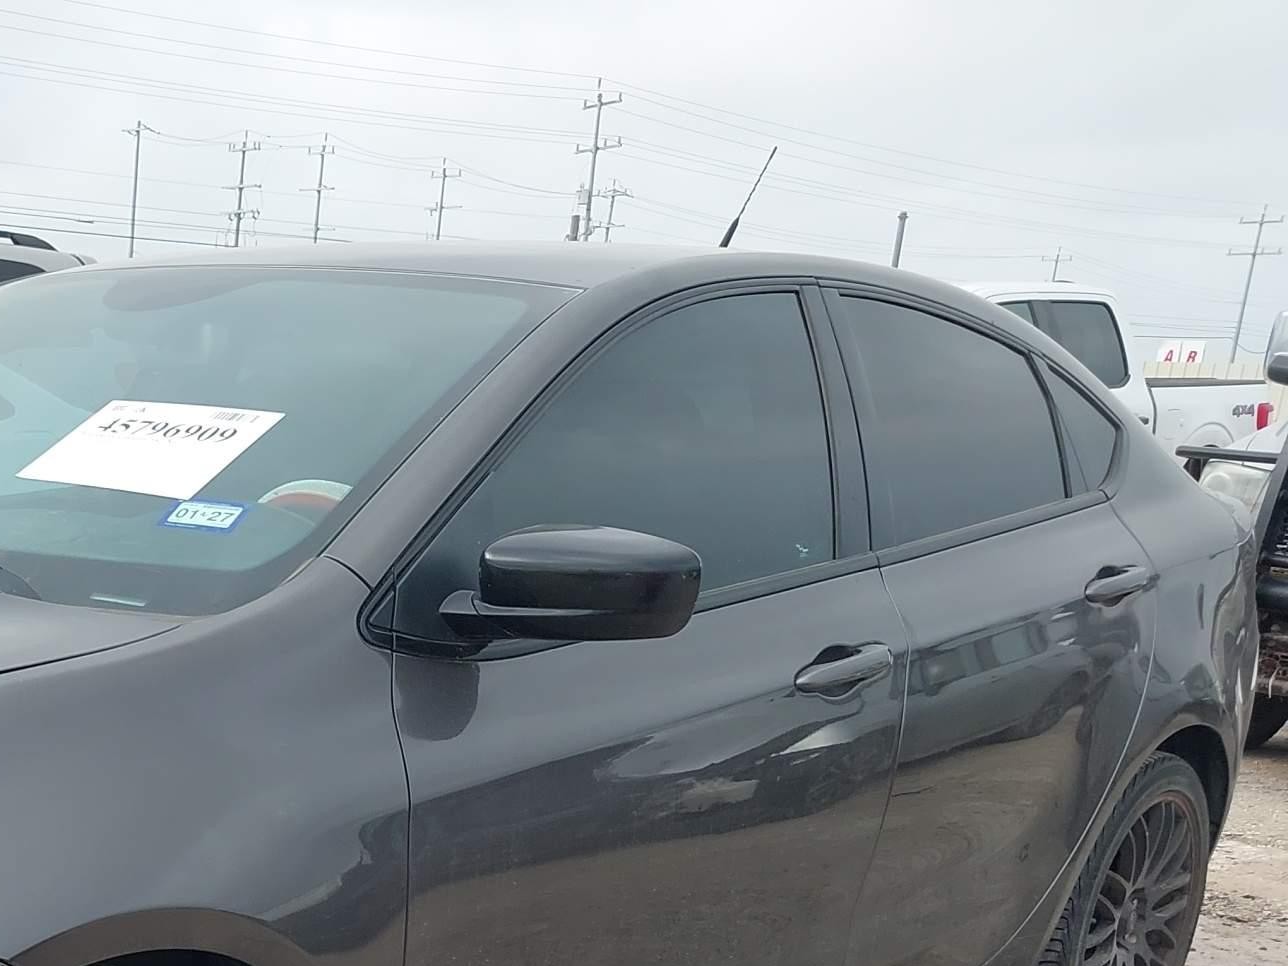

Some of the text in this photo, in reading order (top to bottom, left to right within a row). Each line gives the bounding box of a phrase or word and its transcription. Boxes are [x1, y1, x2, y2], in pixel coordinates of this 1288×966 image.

[1164, 350, 1198, 363] A R
[98, 417, 238, 442] 45796909
[175, 507, 197, 520] 01
[206, 510, 235, 524] 27
